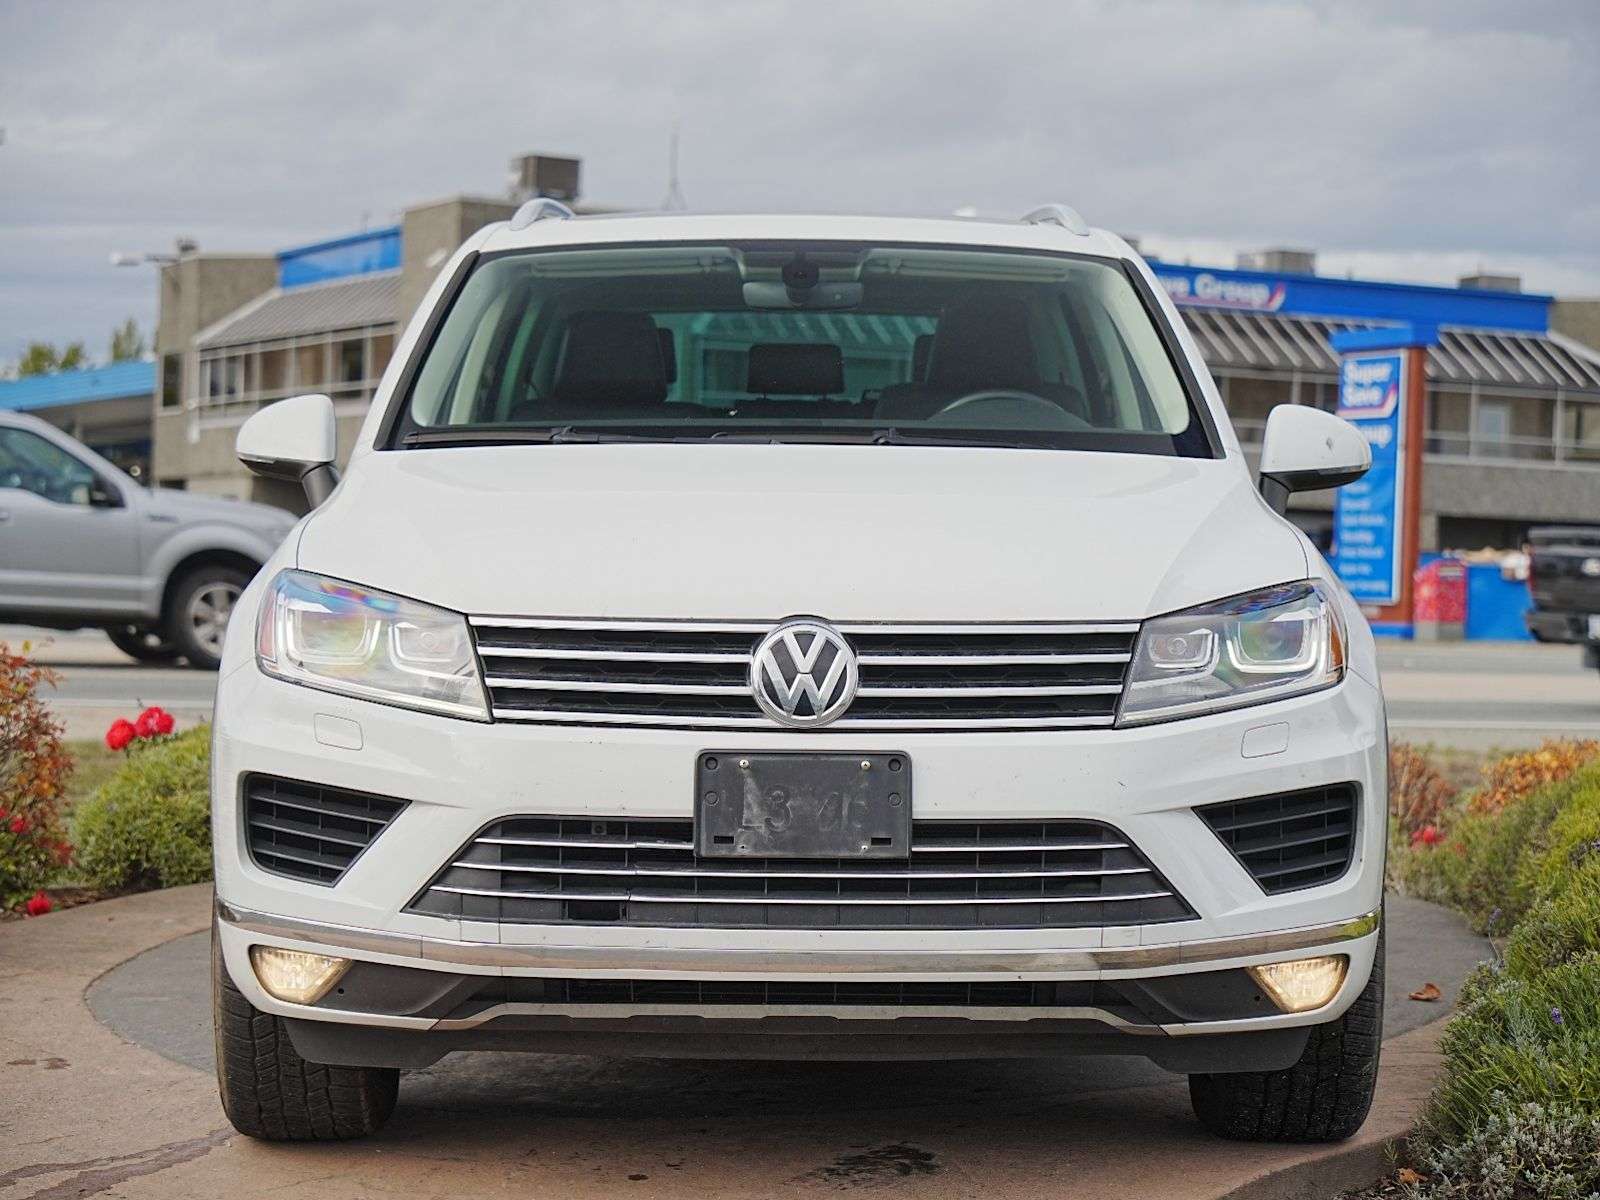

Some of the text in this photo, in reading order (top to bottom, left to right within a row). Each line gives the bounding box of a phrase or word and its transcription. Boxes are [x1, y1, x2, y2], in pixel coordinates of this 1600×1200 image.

[1195, 272, 1270, 305] Group
[1343, 361, 1392, 384] Super
[751, 622, 858, 727] VW
